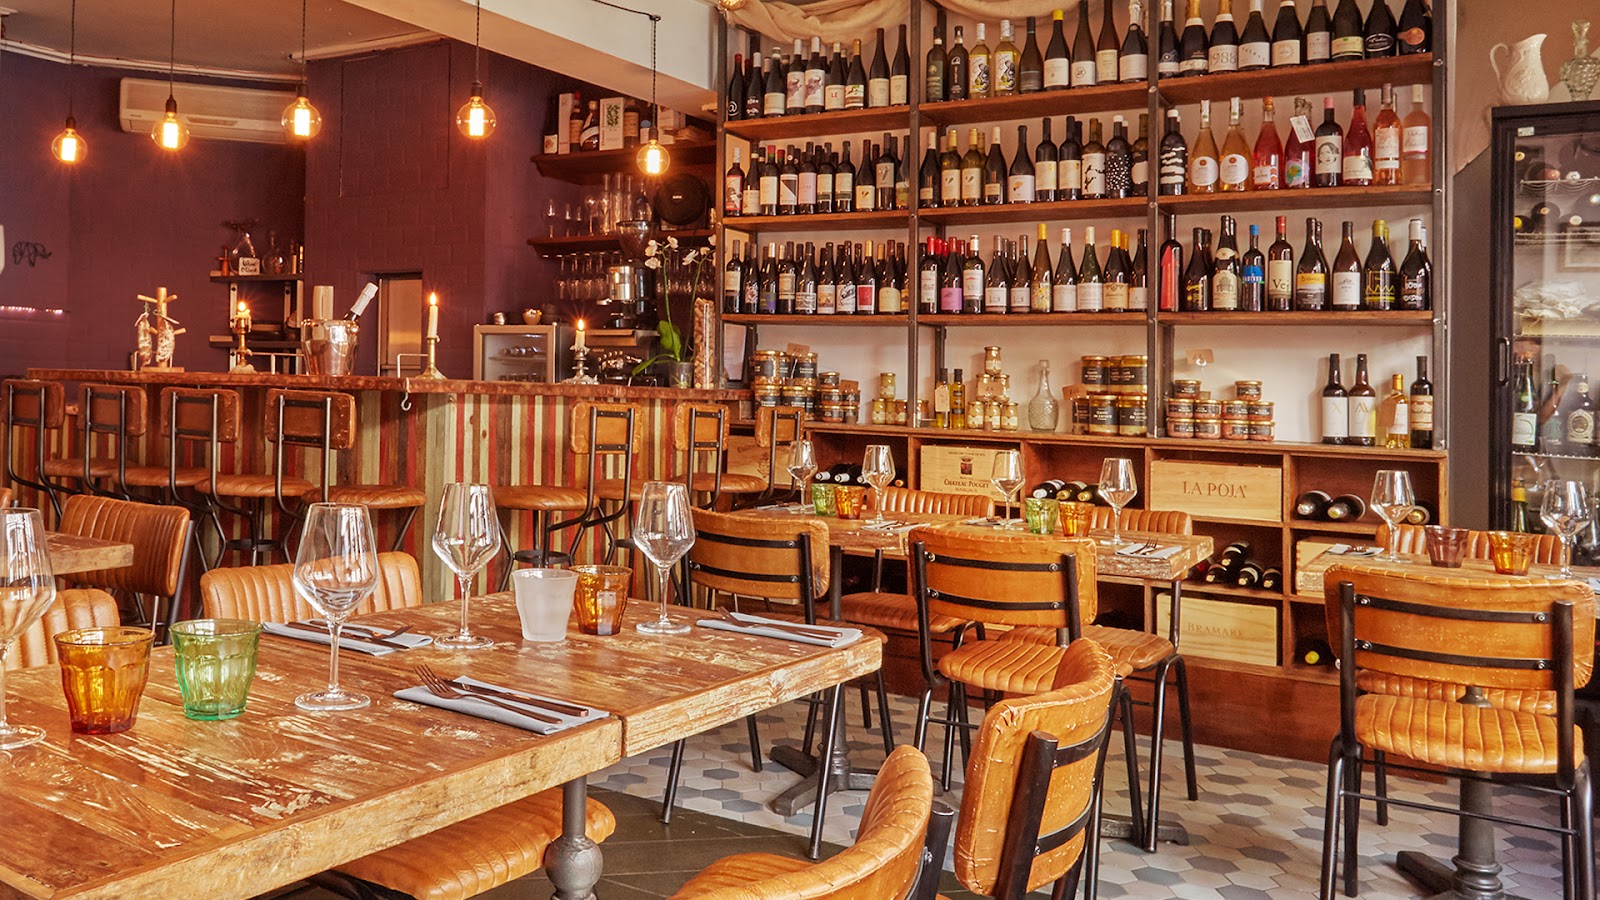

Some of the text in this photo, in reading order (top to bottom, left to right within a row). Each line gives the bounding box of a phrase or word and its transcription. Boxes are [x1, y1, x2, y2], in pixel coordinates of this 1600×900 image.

[1210, 51, 1237, 66] 1988
[968, 480, 989, 489] POUGET
[1183, 481, 1202, 495] LA
[1188, 623, 1244, 638] BRAMARE
